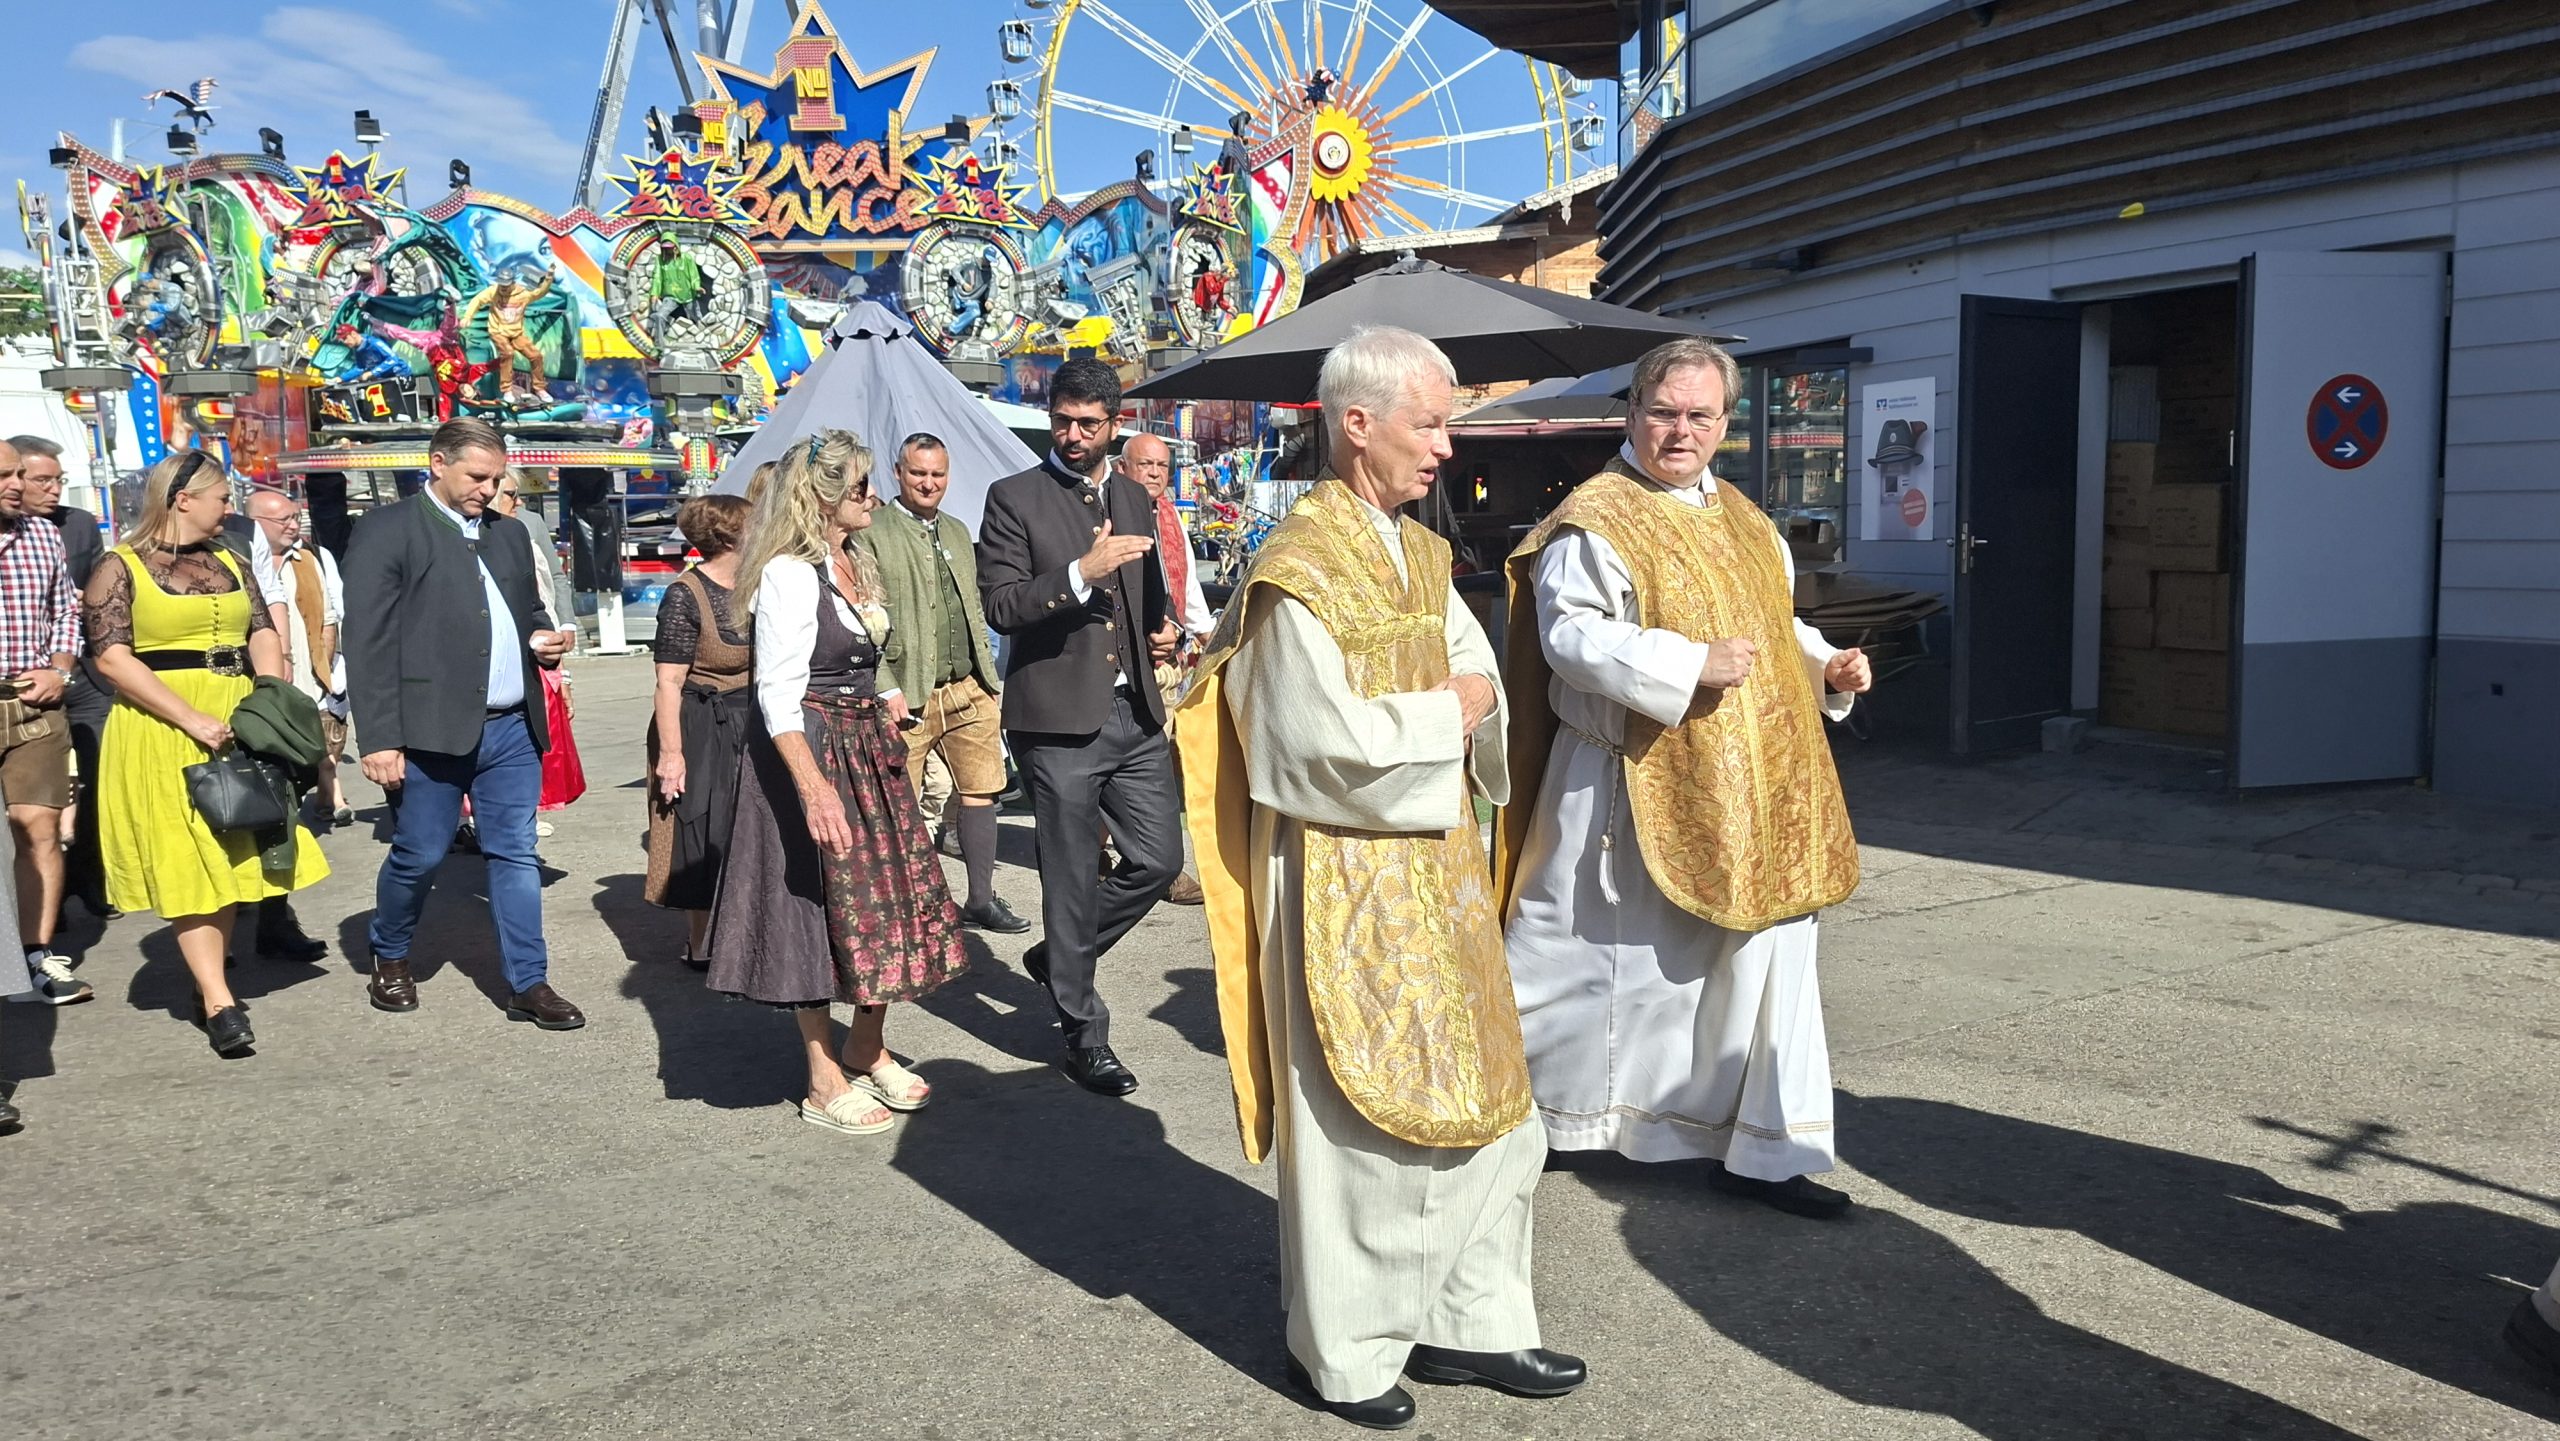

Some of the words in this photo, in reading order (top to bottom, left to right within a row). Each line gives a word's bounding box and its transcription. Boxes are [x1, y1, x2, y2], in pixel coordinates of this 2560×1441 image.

[663, 152, 684, 181] 1
[636, 168, 728, 204] Break
[941, 169, 1013, 211] Break
[621, 193, 734, 219] Dance
[732, 184, 934, 240] Dance
[928, 192, 1018, 222] Dance
[366, 384, 391, 417] 1
